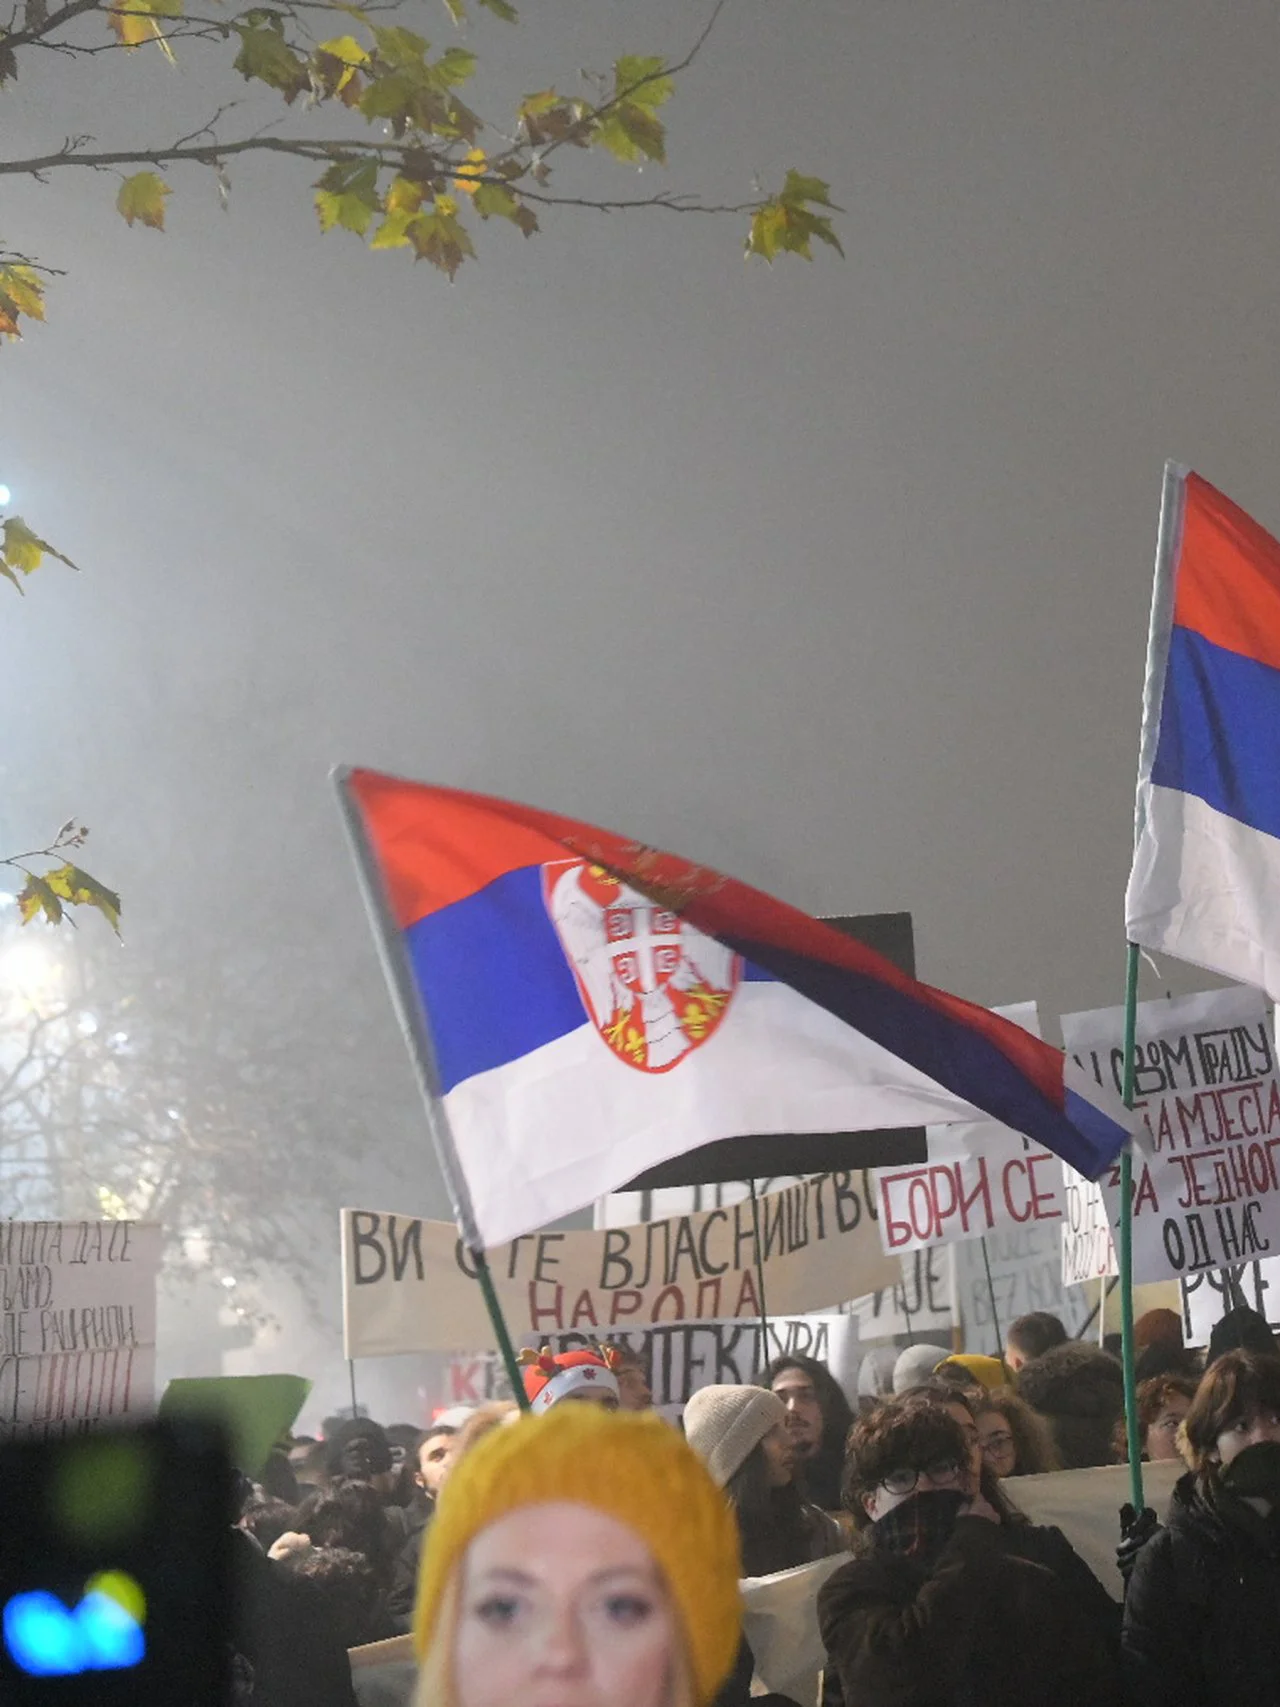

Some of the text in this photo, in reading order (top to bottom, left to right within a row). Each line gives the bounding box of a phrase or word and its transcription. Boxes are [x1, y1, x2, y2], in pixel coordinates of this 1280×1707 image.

[1194, 1023, 1273, 1085] ГРАДУ
[880, 1156, 995, 1248] БОРИ
[1003, 1153, 1062, 1222] СЕ
[1163, 1213, 1216, 1271] ОД
[1214, 1201, 1269, 1261] НАС
[351, 1210, 425, 1285] ВИ
